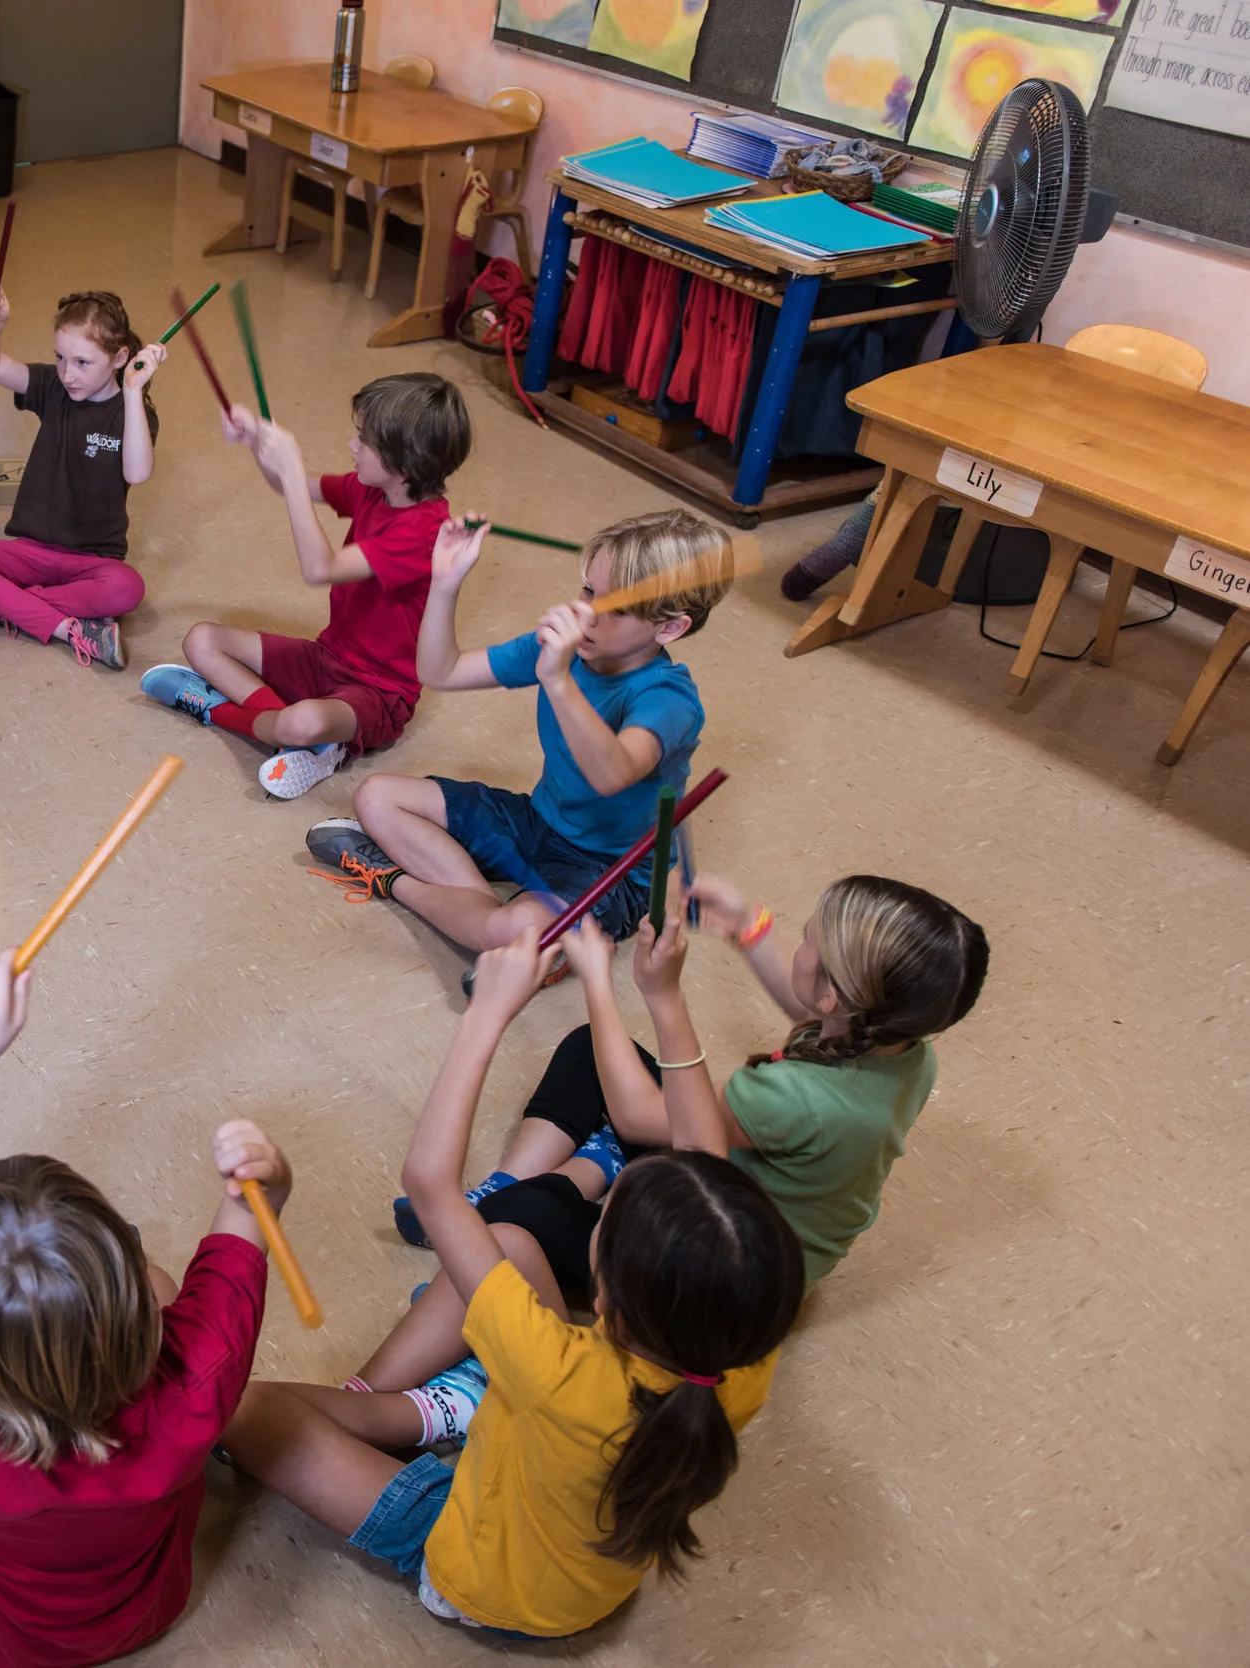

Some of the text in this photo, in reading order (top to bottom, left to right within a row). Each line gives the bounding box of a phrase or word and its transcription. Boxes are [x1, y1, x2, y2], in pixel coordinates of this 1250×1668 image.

[1184, 0, 1228, 41] great
[1122, 35, 1162, 83] Through
[1200, 67, 1236, 90] across
[966, 461, 1002, 502] Lily
